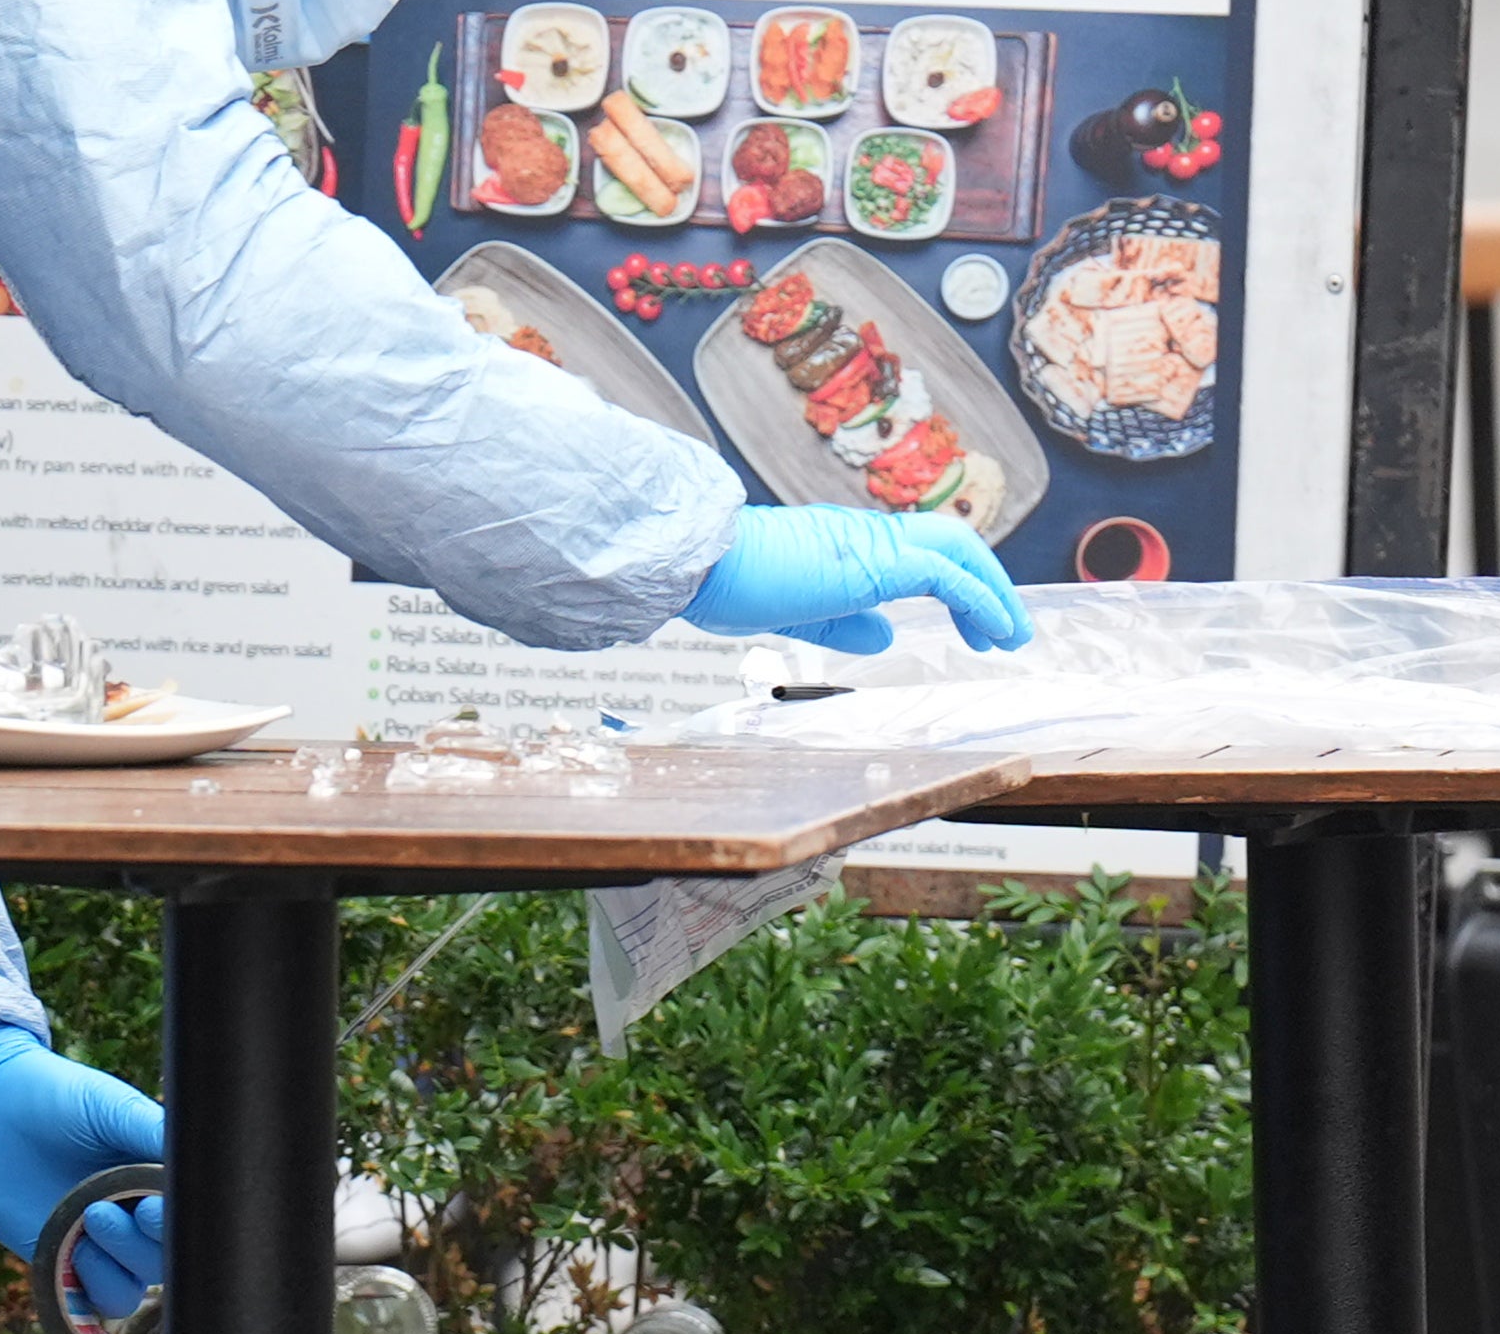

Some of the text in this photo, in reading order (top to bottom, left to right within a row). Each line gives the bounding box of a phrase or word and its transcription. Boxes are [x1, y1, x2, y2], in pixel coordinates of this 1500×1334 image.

[262, 23, 285, 64] Kolmi
[26, 398, 78, 413] served
[80, 400, 115, 415] with
[14, 457, 39, 476] fry
[43, 460, 75, 476] pan
[80, 460, 136, 476] served
[141, 462, 179, 478] with
[182, 464, 216, 479] rice
[0, 514, 34, 530] with
[214, 523, 265, 538] served
[1, 571, 54, 587] served
[56, 573, 91, 589] with
[170, 575, 200, 592] and
[202, 578, 248, 597] green
[250, 579, 290, 597] salad
[431, 627, 485, 646] Salata
[212, 640, 244, 656] and
[245, 642, 291, 661] green
[293, 643, 334, 660] salad
[386, 654, 431, 675] Roka
[435, 656, 489, 677] Salata
[448, 686, 502, 706] Salata
